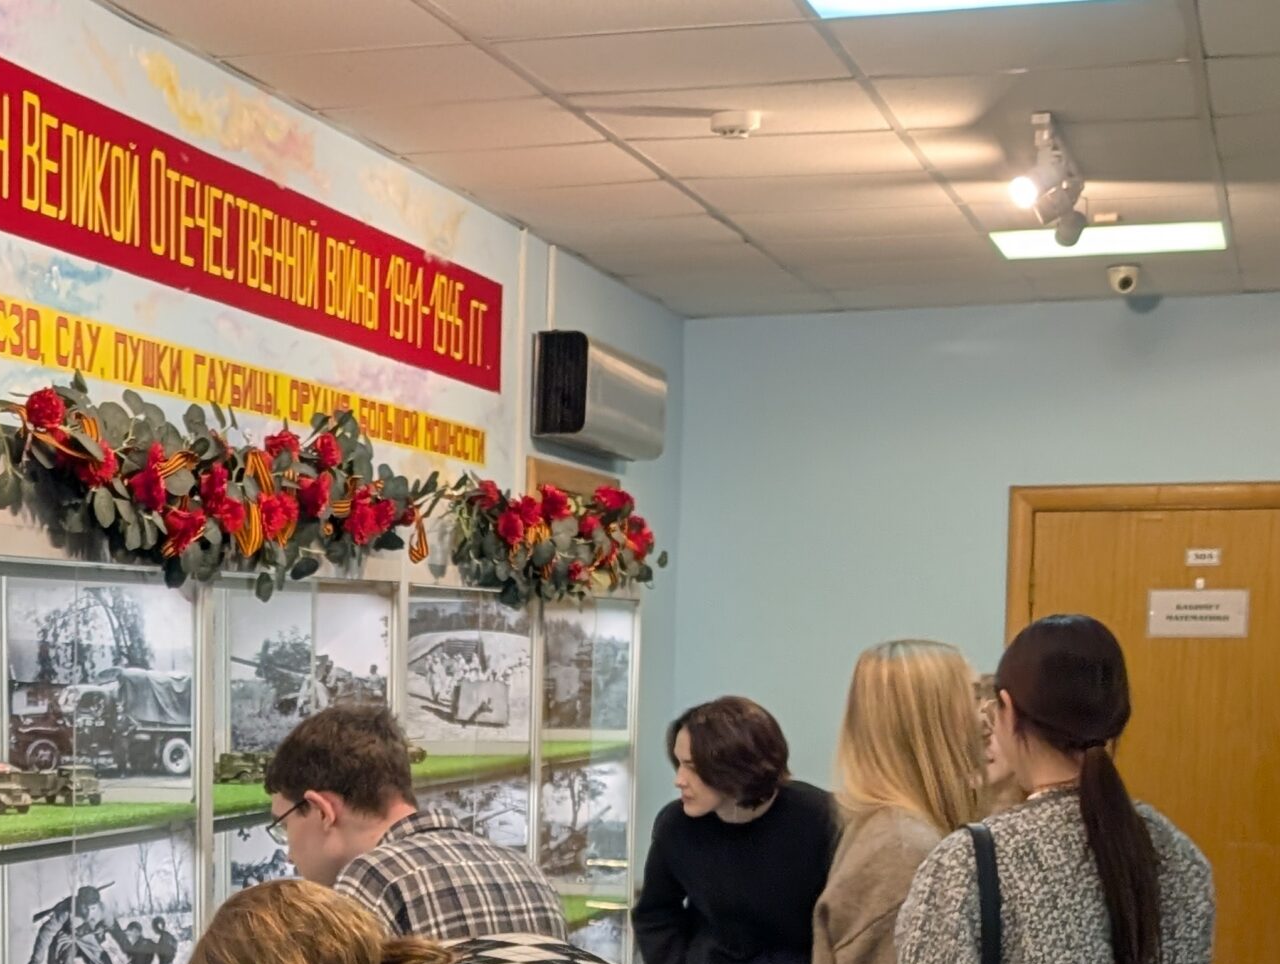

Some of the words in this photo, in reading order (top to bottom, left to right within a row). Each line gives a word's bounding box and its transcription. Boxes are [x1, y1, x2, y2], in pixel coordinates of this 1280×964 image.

[22, 90, 140, 248] ВЕЛИКОЙ
[150, 147, 319, 310] ОТЕЧЕСТВЕННОЙ
[325, 236, 381, 331] ВОЙНЫ
[114, 332, 186, 396] ПУШКИ,
